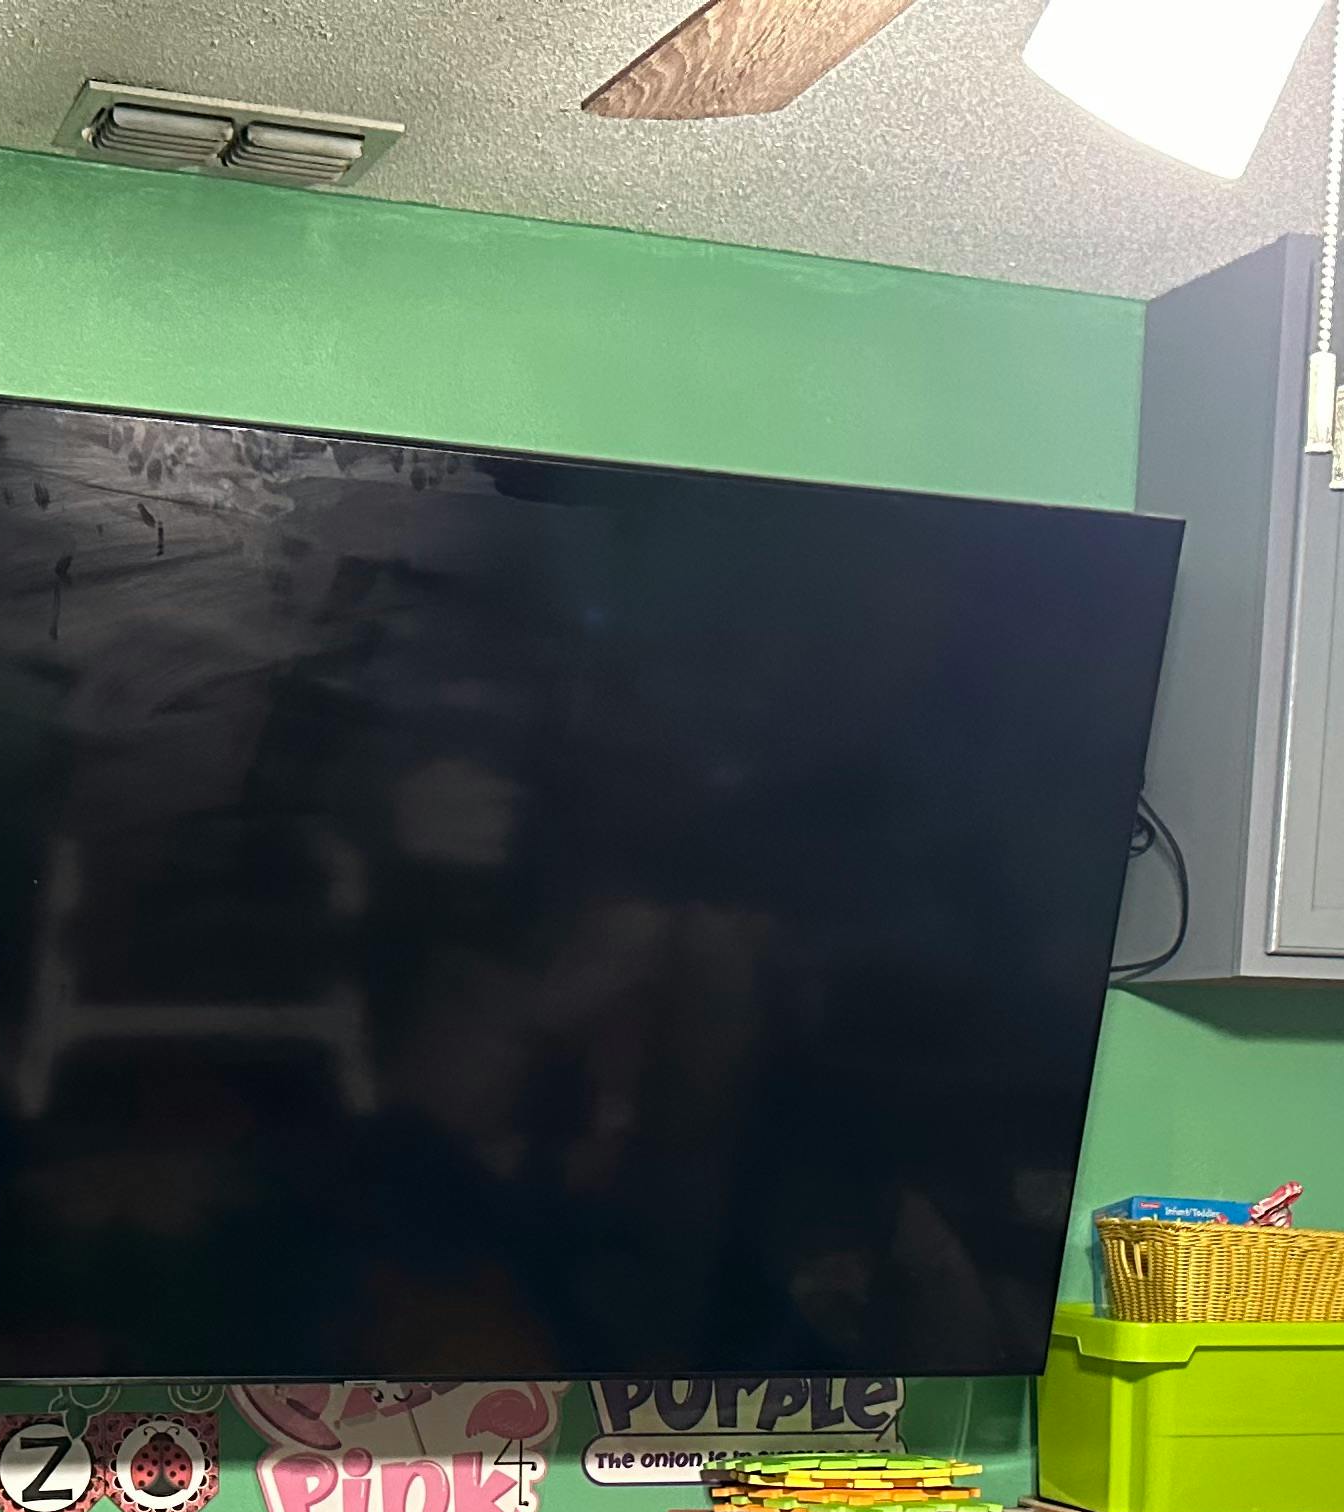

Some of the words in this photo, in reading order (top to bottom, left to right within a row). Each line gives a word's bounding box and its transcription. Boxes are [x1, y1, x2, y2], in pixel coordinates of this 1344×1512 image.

[19, 1437, 74, 1503] Z
[595, 1452, 635, 1469] The
[640, 1451, 703, 1468] onion
